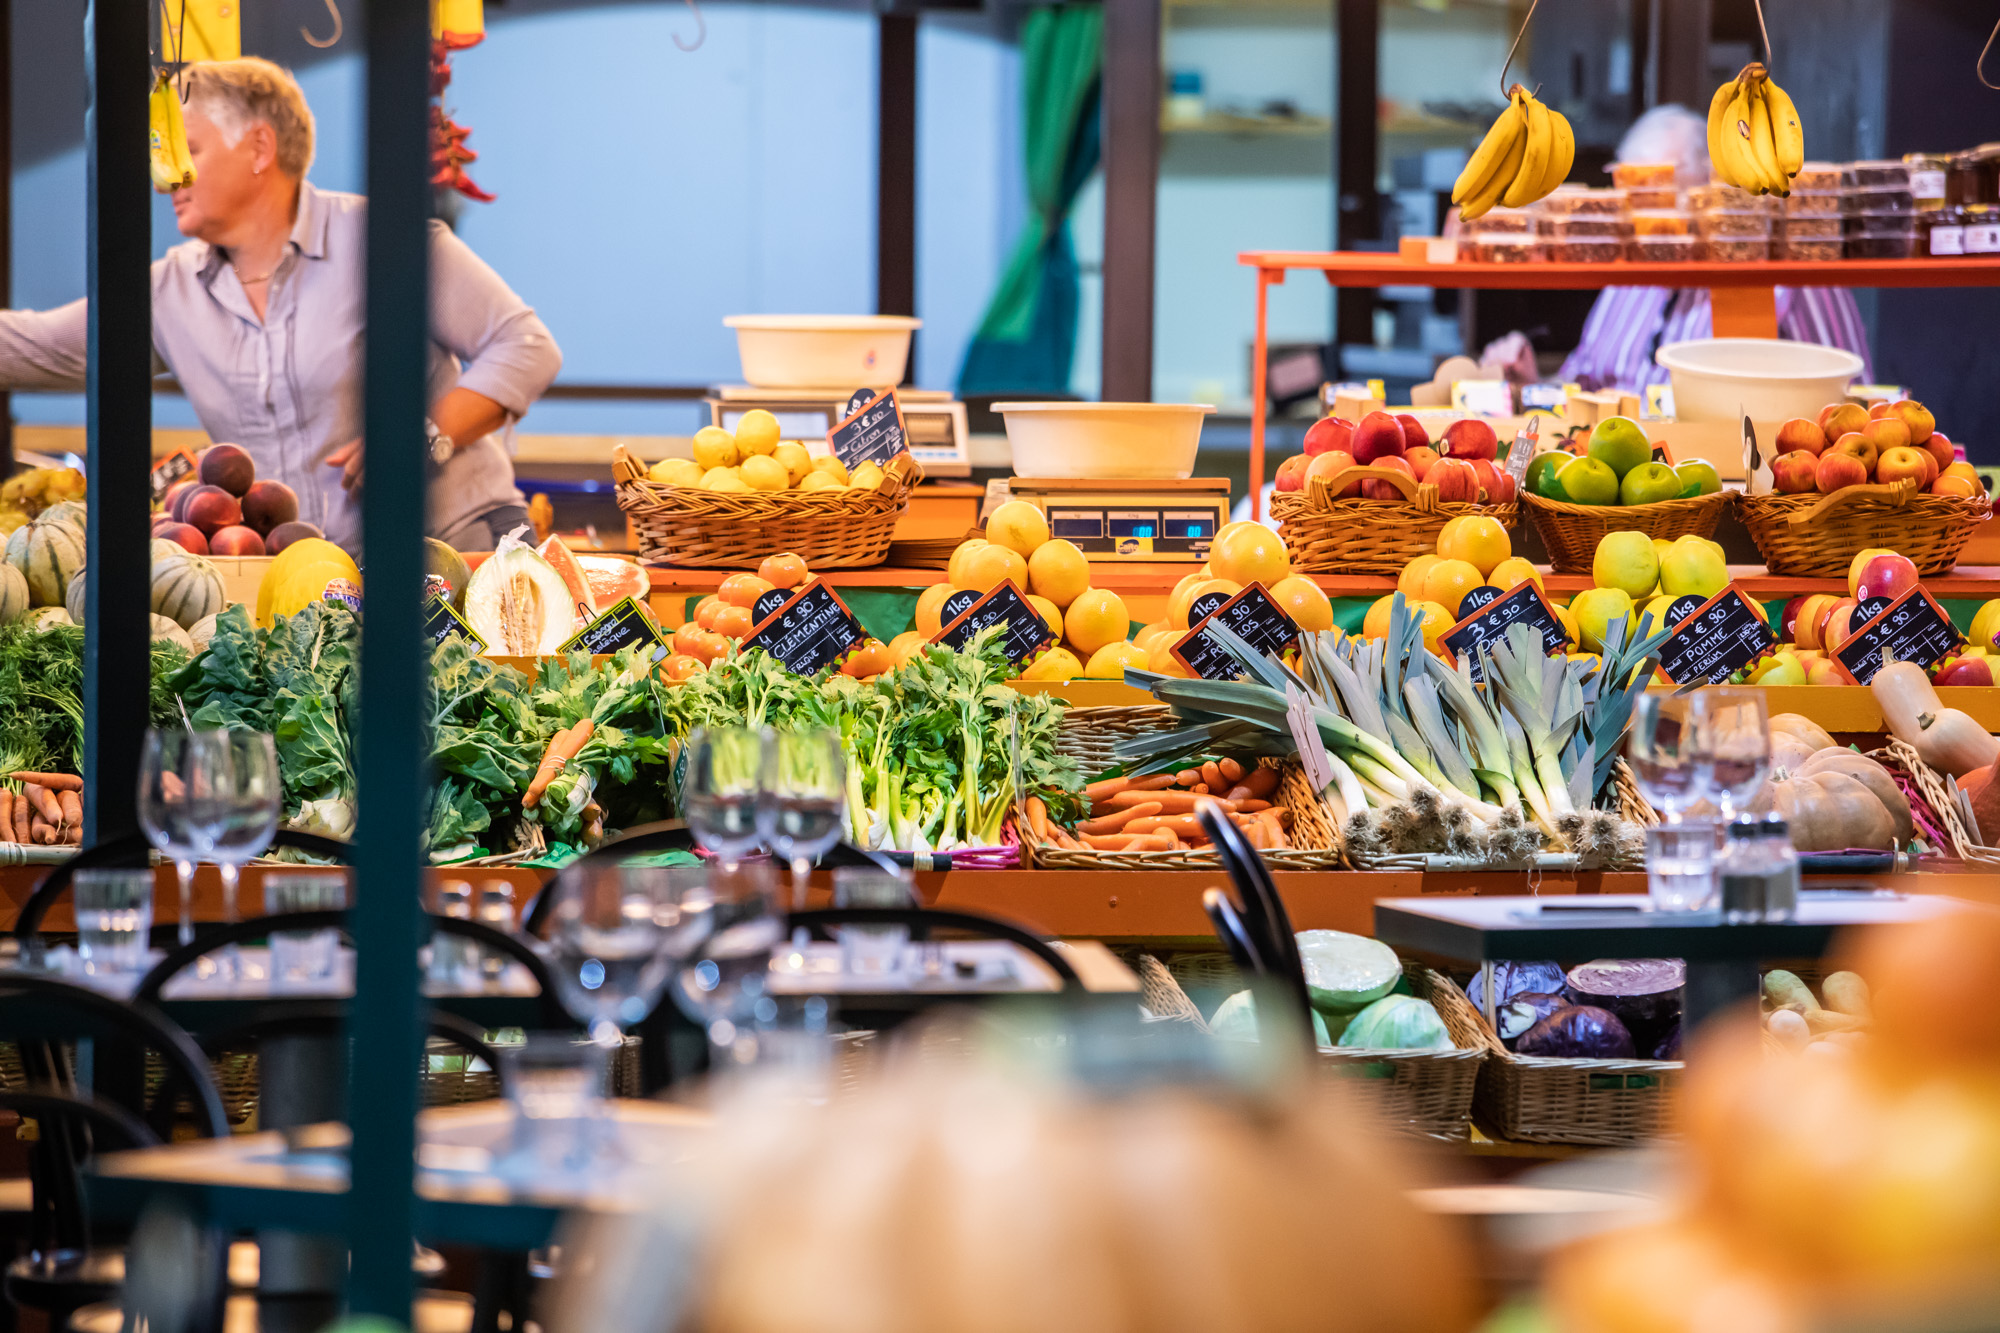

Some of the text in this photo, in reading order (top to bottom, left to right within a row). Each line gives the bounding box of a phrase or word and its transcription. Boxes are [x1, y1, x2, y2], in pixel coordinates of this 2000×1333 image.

[850, 422, 862, 436] 3
[850, 429, 880, 452] Citron
[759, 594, 785, 614] 1kg
[947, 595, 973, 615] 1kg
[1194, 597, 1220, 617] 1kg
[1467, 591, 1495, 609] 1kg
[1670, 600, 1696, 622] 1kg
[1856, 601, 1883, 621] 1kg
[783, 616, 795, 628] €
[796, 601, 814, 617] 90
[1198, 632, 1211, 646] 3
[1231, 604, 1250, 620] 90
[1467, 622, 1485, 643] 3
[1488, 614, 1501, 626] €
[1502, 604, 1520, 620] 90
[961, 625, 975, 639] 2
[971, 617, 983, 629] €
[1678, 634, 1690, 645] 3
[1695, 622, 1707, 634] €
[1708, 609, 1726, 623] 90
[1865, 633, 1879, 645] 3
[1880, 623, 1893, 636] €
[1892, 611, 1909, 625] 90
[1210, 619, 1259, 658] POLOS
[1686, 627, 1728, 661] POMME
[1867, 635, 1909, 664] Pome
[1707, 664, 1731, 684] ANCE
